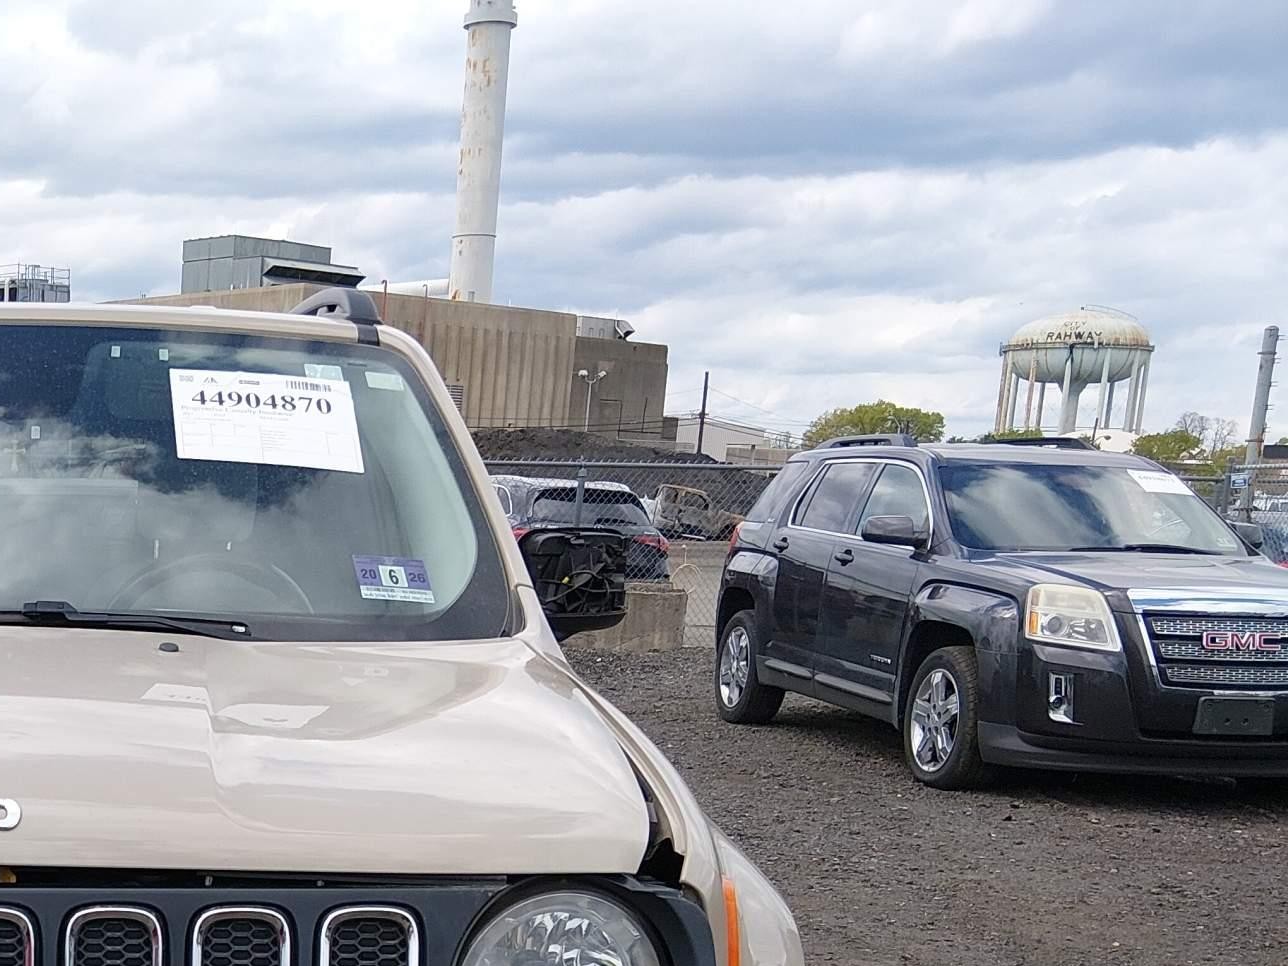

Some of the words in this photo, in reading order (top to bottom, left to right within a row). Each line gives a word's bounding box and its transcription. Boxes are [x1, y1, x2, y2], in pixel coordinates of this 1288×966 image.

[1046, 331, 1103, 341] RAHWAY
[191, 389, 333, 415] 44904870
[360, 568, 377, 579] 20
[388, 568, 400, 585] 6
[408, 572, 426, 583] 26
[1202, 631, 1282, 651] GMC
